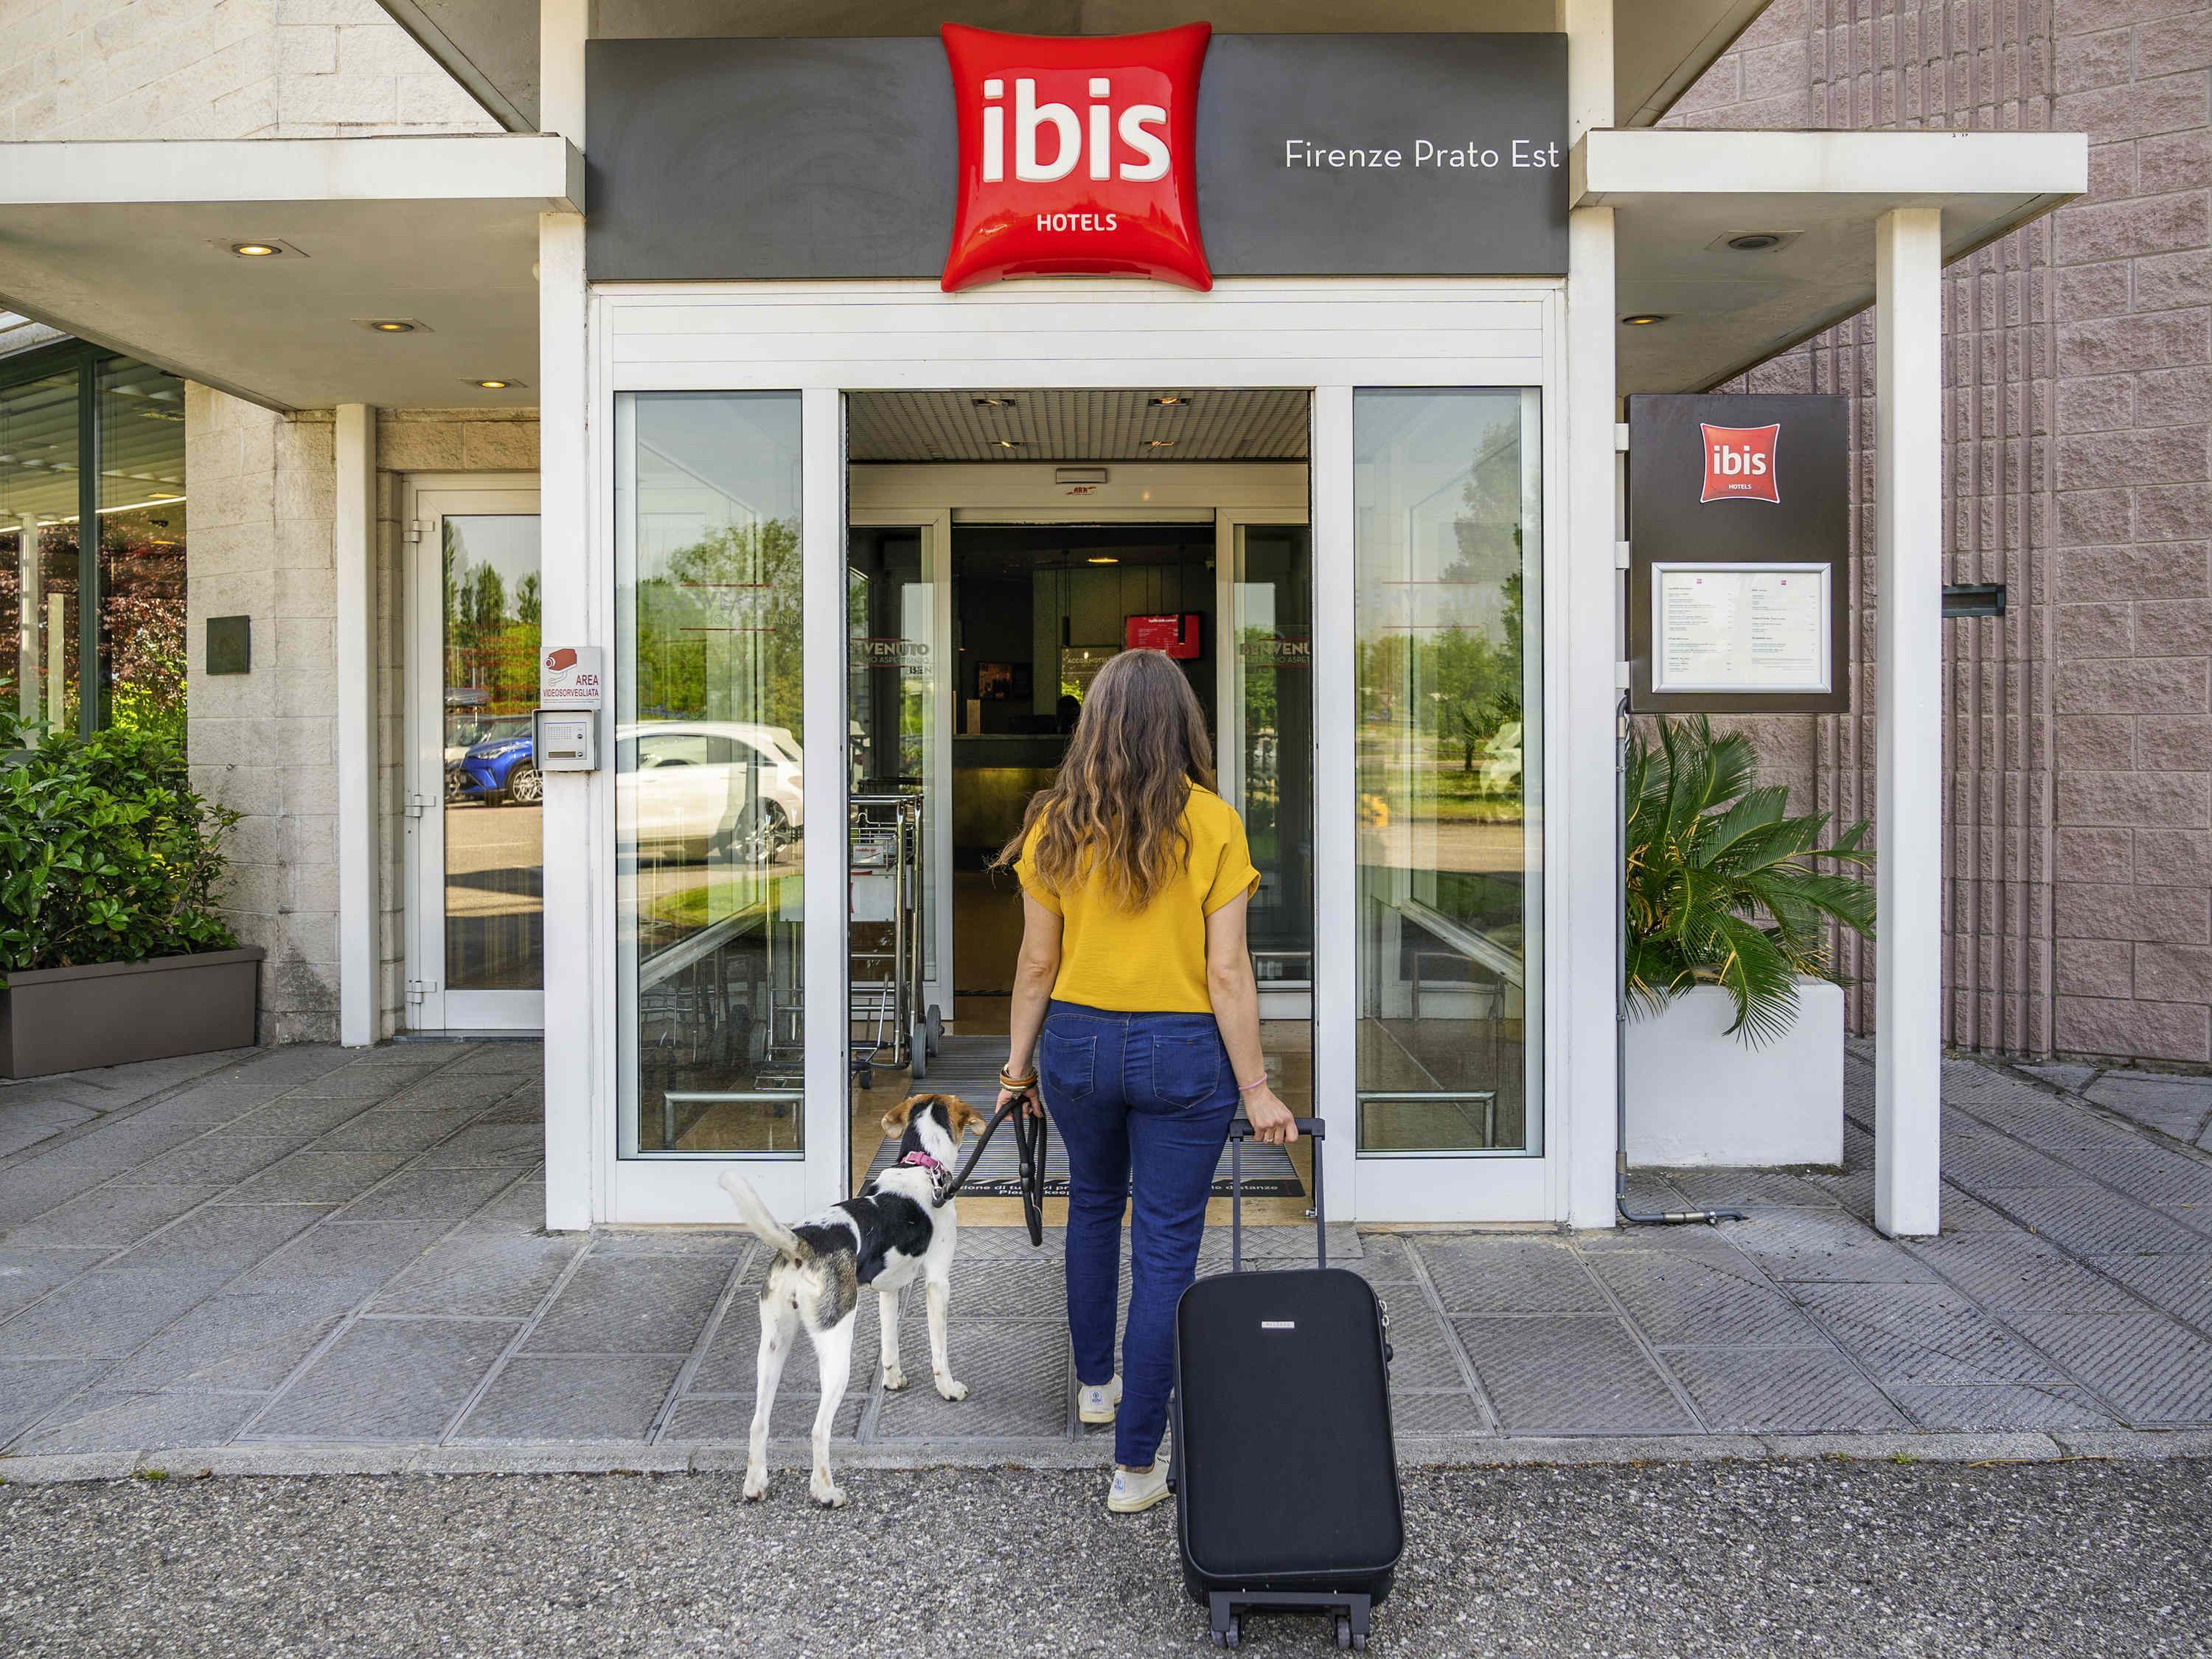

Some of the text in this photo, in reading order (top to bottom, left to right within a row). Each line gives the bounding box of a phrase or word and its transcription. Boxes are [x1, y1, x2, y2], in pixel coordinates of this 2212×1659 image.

[983, 77, 1171, 183] ibis
[1286, 139, 1559, 168] Firenze Prato Est
[1037, 213, 1117, 232] HOTELS
[1714, 445, 1767, 476] ibis
[576, 675, 599, 686] AREA
[543, 689, 599, 697] VIDEOSORVEGLIATA
